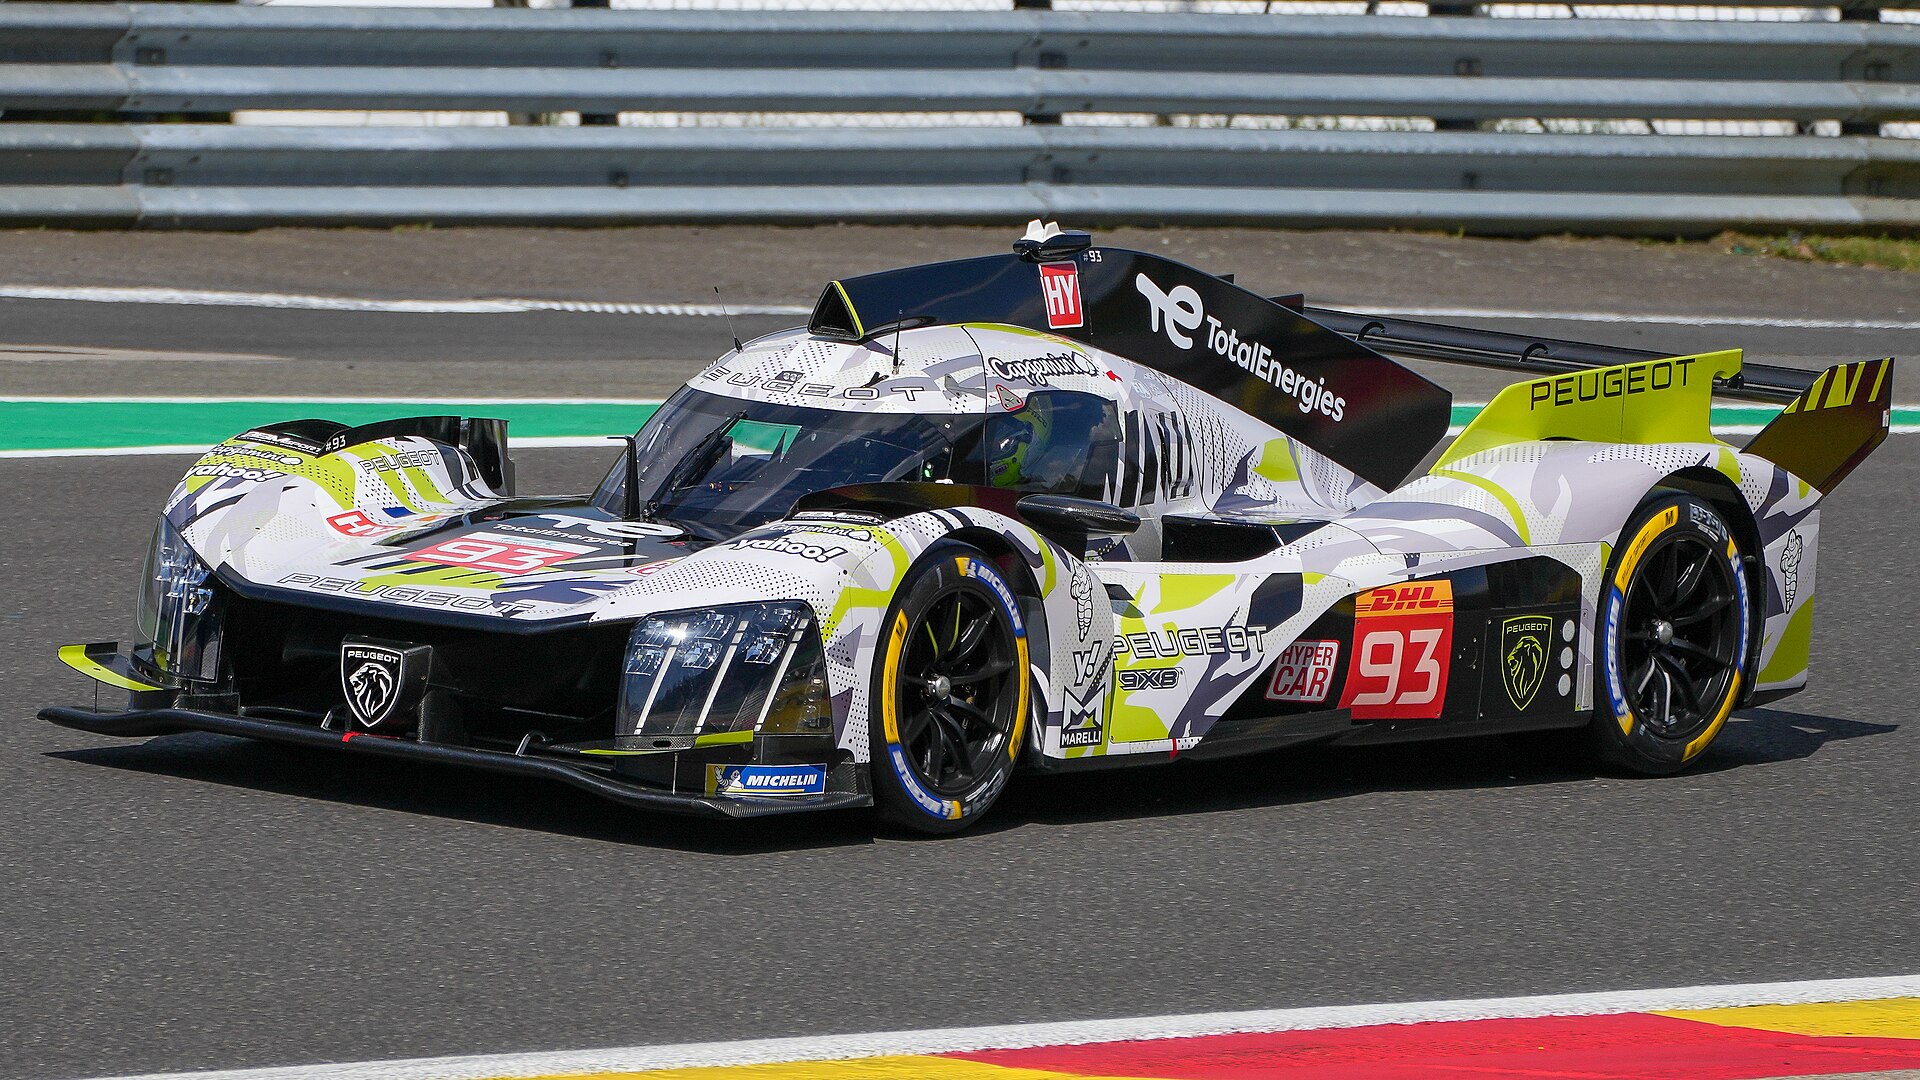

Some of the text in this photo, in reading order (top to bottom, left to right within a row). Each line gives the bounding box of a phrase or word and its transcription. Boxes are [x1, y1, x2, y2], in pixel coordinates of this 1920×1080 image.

[1083, 250, 1102, 262] #93
[1044, 274, 1076, 316] HY
[703, 359, 926, 402] EUGEOT
[988, 352, 1082, 387] Capgemini
[1206, 315, 1346, 422] TotalEnergies
[1530, 358, 1696, 411] PEUGEOT
[325, 435, 346, 452] #93
[182, 463, 288, 482] yahoo!
[358, 450, 439, 474] PEUGEOT
[492, 523, 634, 548] TotalEnergies
[415, 541, 565, 571] 93
[729, 538, 848, 562] yahoo!
[277, 573, 536, 617] PEUGEOT
[1370, 587, 1442, 612] DHL
[1506, 623, 1549, 634] PEUGEOT
[1111, 626, 1268, 660] PEUGEOT
[347, 650, 399, 664] PEUGEOT
[1281, 645, 1333, 668] HYPER
[1351, 628, 1443, 705] 93
[1118, 669, 1180, 691] 9X8
[1272, 667, 1329, 698] CAR
[1061, 731, 1102, 745] MARELLI
[746, 773, 818, 788] MICHELIN
